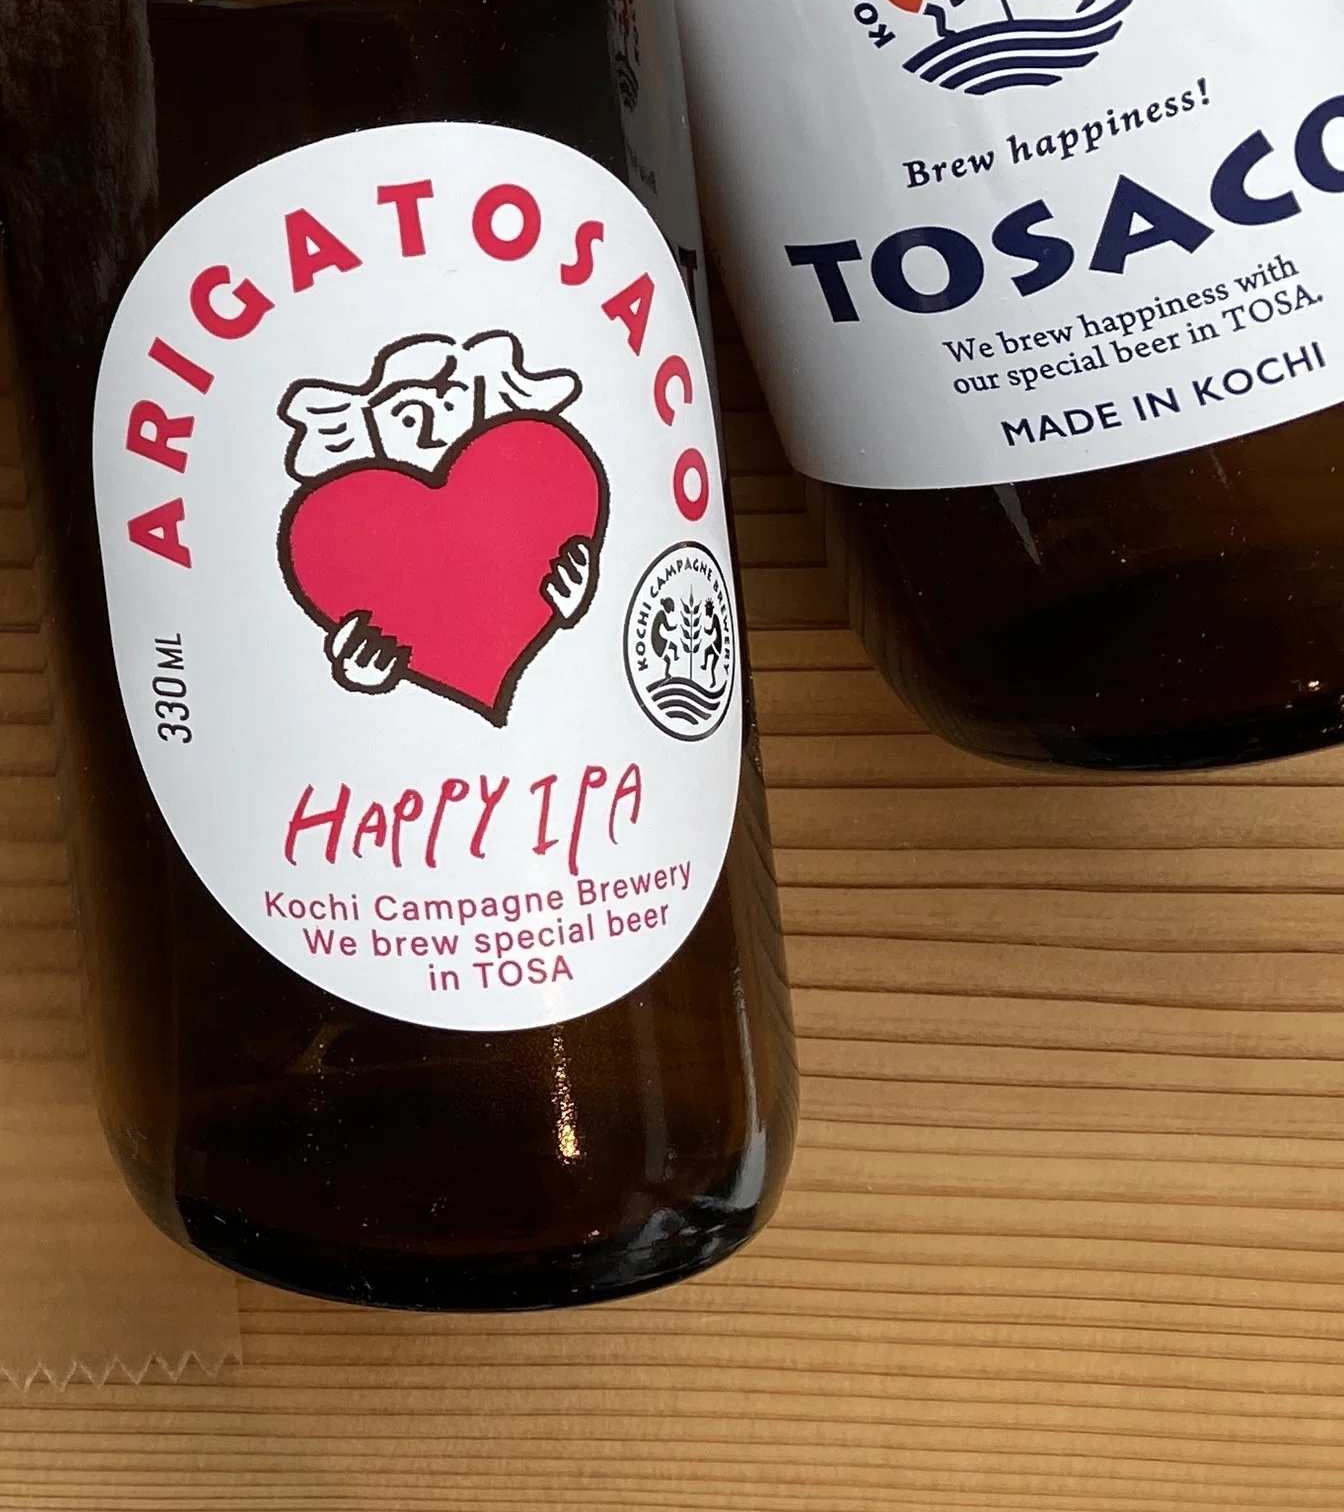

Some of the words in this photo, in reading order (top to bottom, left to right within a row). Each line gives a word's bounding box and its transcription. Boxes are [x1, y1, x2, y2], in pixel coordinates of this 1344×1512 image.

[902, 151, 995, 188] Brew
[1006, 77, 1211, 165] happiness!
[942, 338, 995, 364] We
[995, 325, 1075, 356] brew
[1078, 283, 1230, 339] happiness
[1233, 254, 1300, 294] with
[953, 373, 1000, 395] our
[1007, 345, 1110, 391] special
[1110, 333, 1182, 365] beer
[1186, 319, 1221, 345] in
[1221, 284, 1324, 333] TOSA.
[127, 179, 710, 569] ARIGATOSACO
[1000, 403, 1123, 446] MADE
[1132, 387, 1182, 422] IN
[1192, 341, 1327, 407] KOCHI
[635, 601, 652, 672] KOCHI
[650, 557, 713, 599] CAMPAGNE
[284, 774, 510, 868] HAPPY
[529, 763, 643, 877] IPA
[264, 891, 360, 921] Kochi
[374, 888, 564, 926] Campagne
[577, 861, 692, 906] Brewery
[302, 928, 358, 957] We
[372, 930, 459, 957] brew
[474, 914, 595, 959] special
[607, 903, 670, 938] beer
[428, 963, 460, 991] in
[473, 955, 575, 990] TOSA
